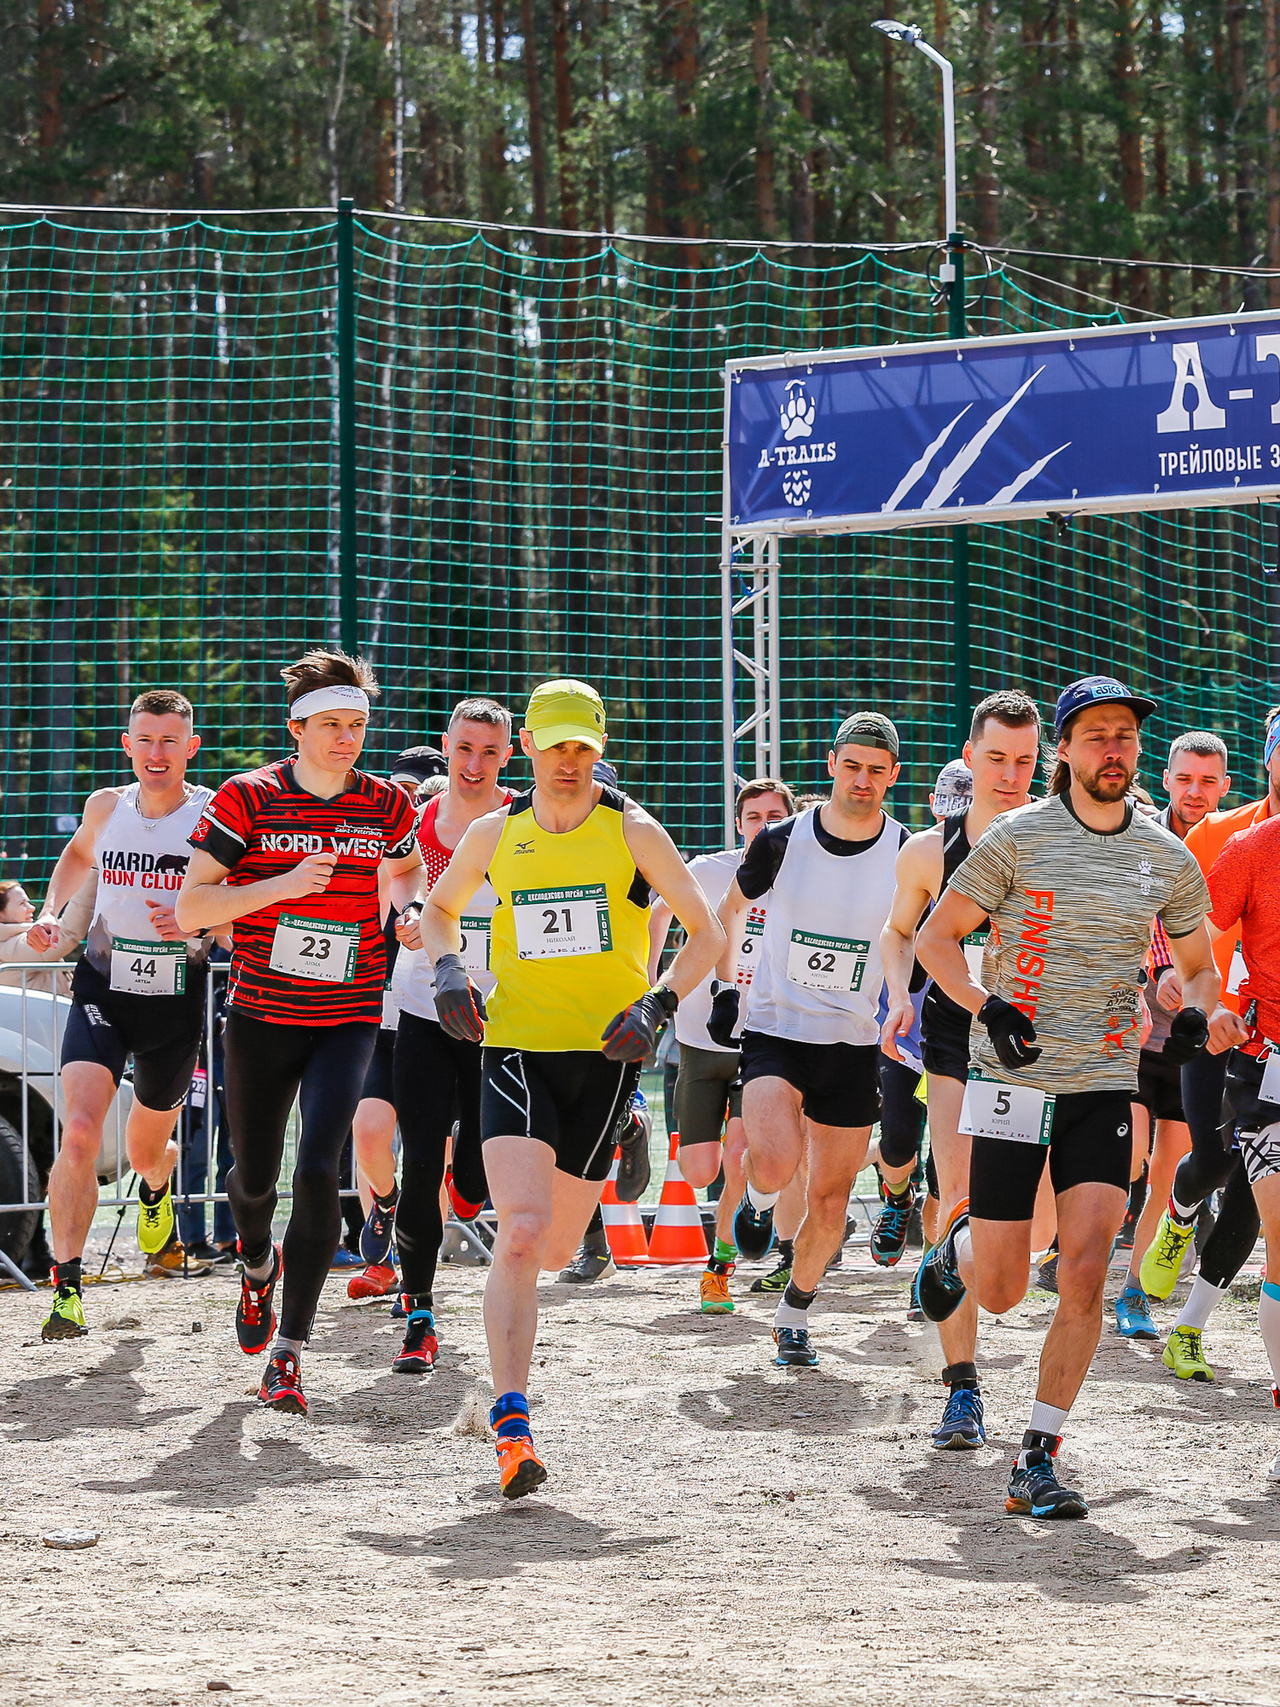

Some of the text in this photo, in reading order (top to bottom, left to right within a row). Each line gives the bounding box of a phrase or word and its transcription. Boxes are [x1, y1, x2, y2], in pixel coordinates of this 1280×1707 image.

[757, 441, 837, 468] A-TRAILS
[1159, 444, 1262, 477] ТРЕЙЛОВЫЕ
[334, 827, 383, 839] Saint-Petersburg
[260, 834, 388, 860] NORD WEST
[102, 850, 155, 873] HARD
[103, 869, 135, 887] RUN
[542, 908, 572, 934] 21
[299, 936, 331, 960] 23
[130, 957, 157, 977] 44
[346, 949, 355, 978] LONG
[807, 952, 836, 973] 62
[993, 1090, 1011, 1115] 5
[1043, 1105, 1051, 1138] LONG
